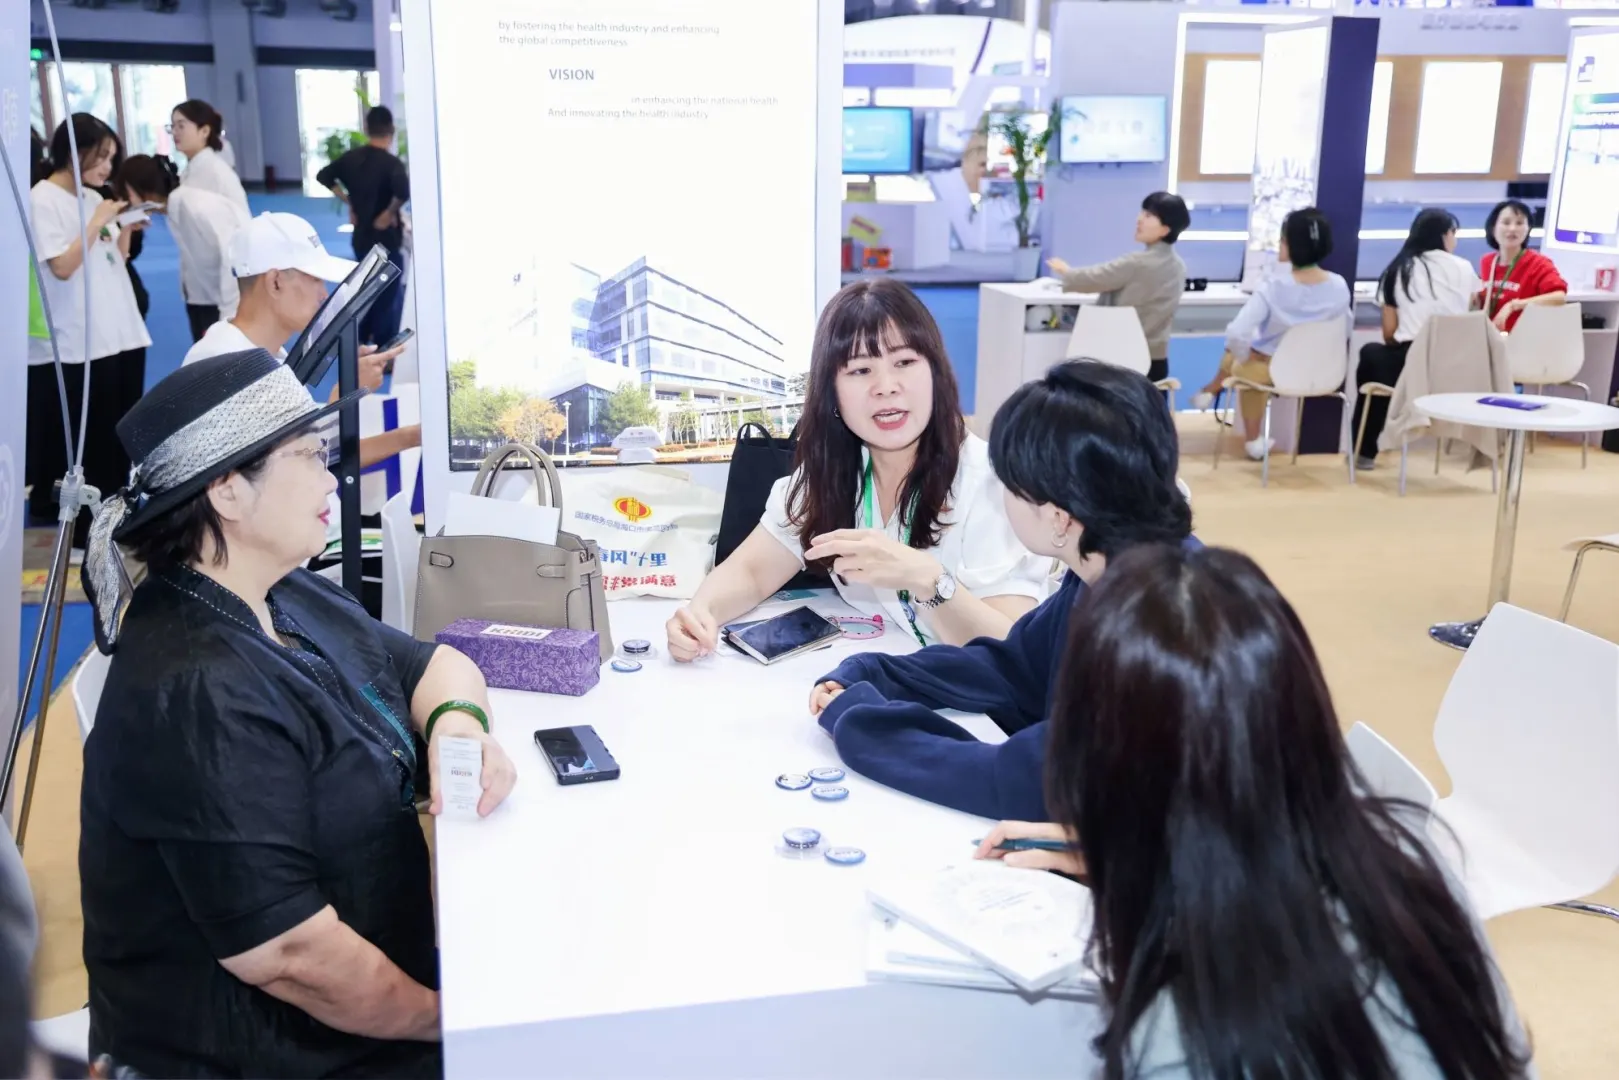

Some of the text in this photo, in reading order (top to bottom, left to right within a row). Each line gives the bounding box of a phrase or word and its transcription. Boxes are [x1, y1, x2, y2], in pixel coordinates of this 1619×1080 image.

[498, 20, 720, 36] by fostering the health industry and enhancing
[498, 35, 629, 48] the global competitiveness
[548, 68, 595, 81] VISION
[642, 94, 692, 107] enhancing
[693, 95, 709, 105] the
[710, 95, 748, 106] national
[749, 96, 779, 106] health
[547, 107, 567, 117] And
[568, 107, 621, 120] innovating
[622, 108, 638, 118] the
[639, 108, 669, 119] health
